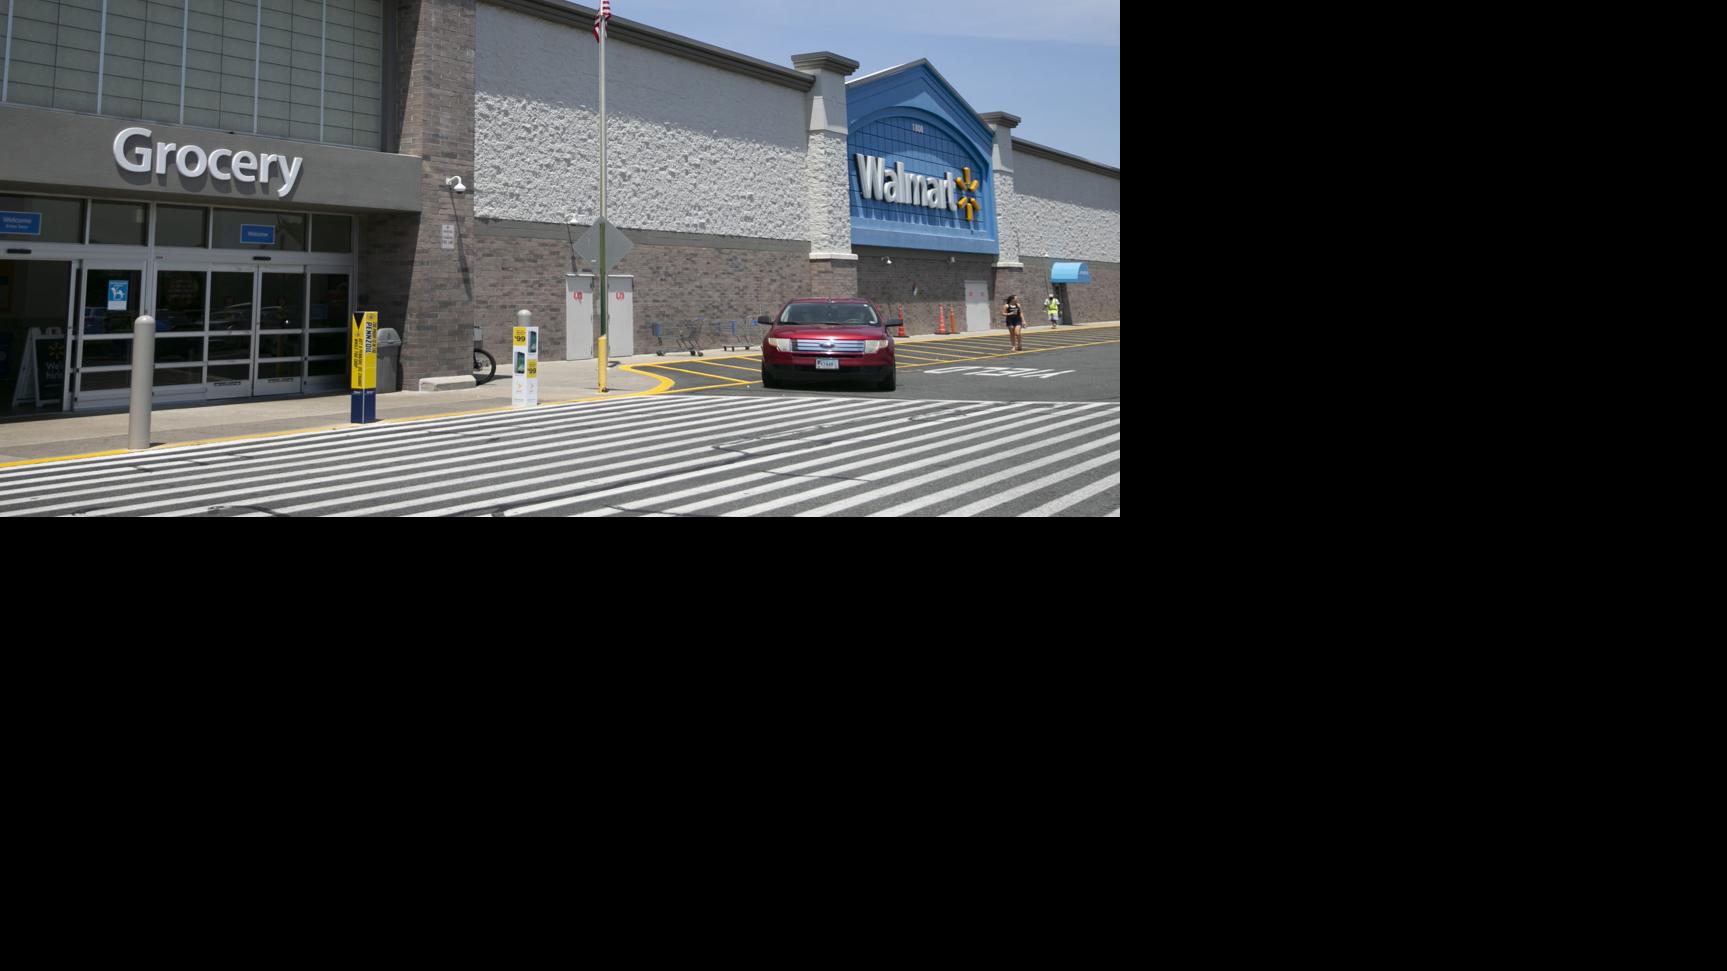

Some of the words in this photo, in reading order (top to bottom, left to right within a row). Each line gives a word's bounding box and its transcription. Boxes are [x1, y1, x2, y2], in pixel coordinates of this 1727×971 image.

[112, 126, 304, 198] Grocery
[855, 152, 957, 212] Walmart
[365, 322, 373, 353] PENNZOIL
